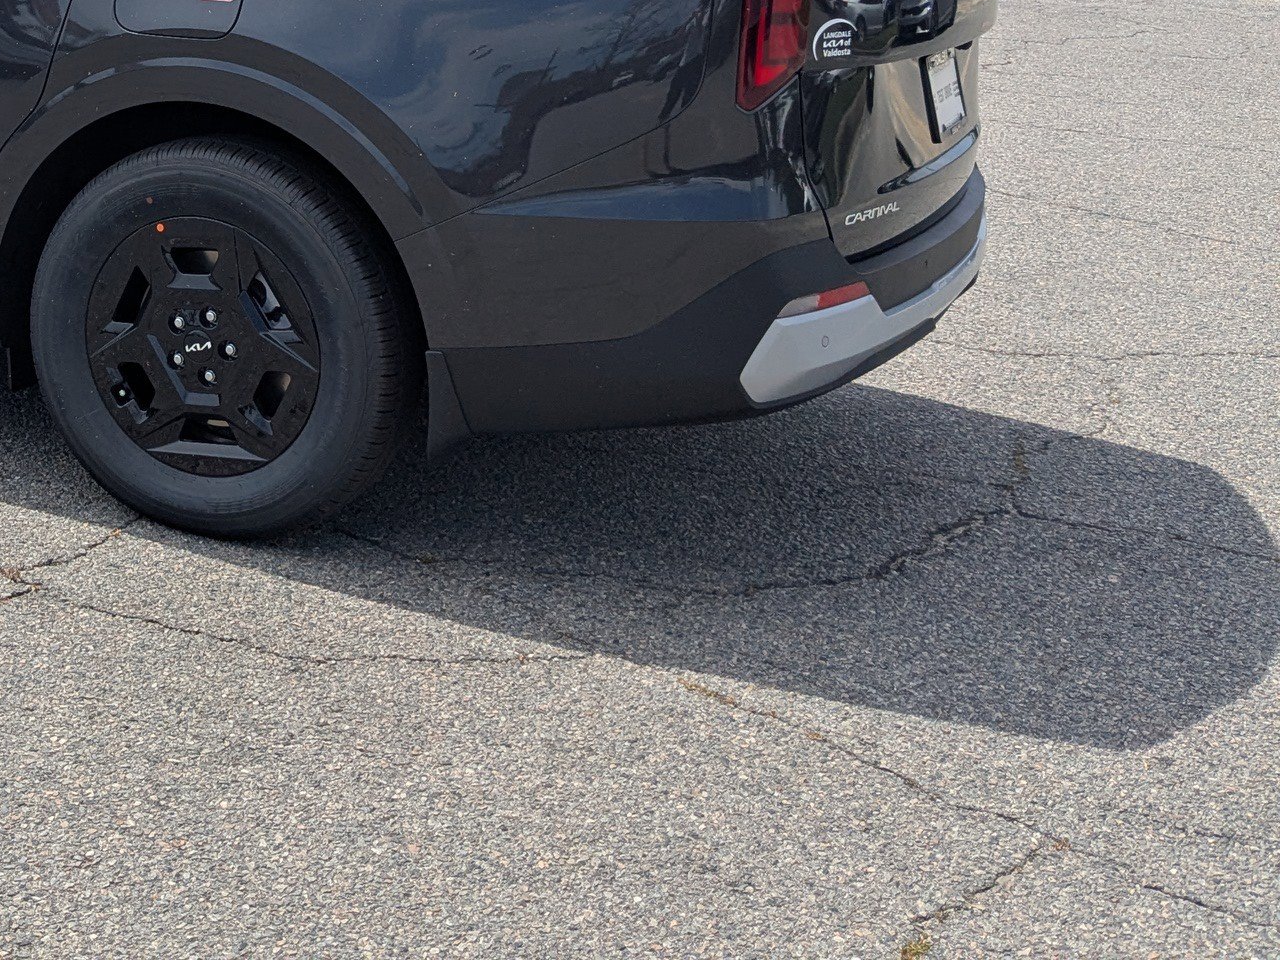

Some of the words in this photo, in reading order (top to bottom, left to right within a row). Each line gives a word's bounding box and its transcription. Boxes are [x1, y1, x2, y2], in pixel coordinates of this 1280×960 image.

[823, 30, 852, 39] LANGDALE
[823, 39, 844, 48] KIA
[844, 38, 852, 46] of
[823, 48, 851, 57] Valdosta
[845, 201, 900, 226] CARNIVAL
[185, 341, 212, 353] KIA
